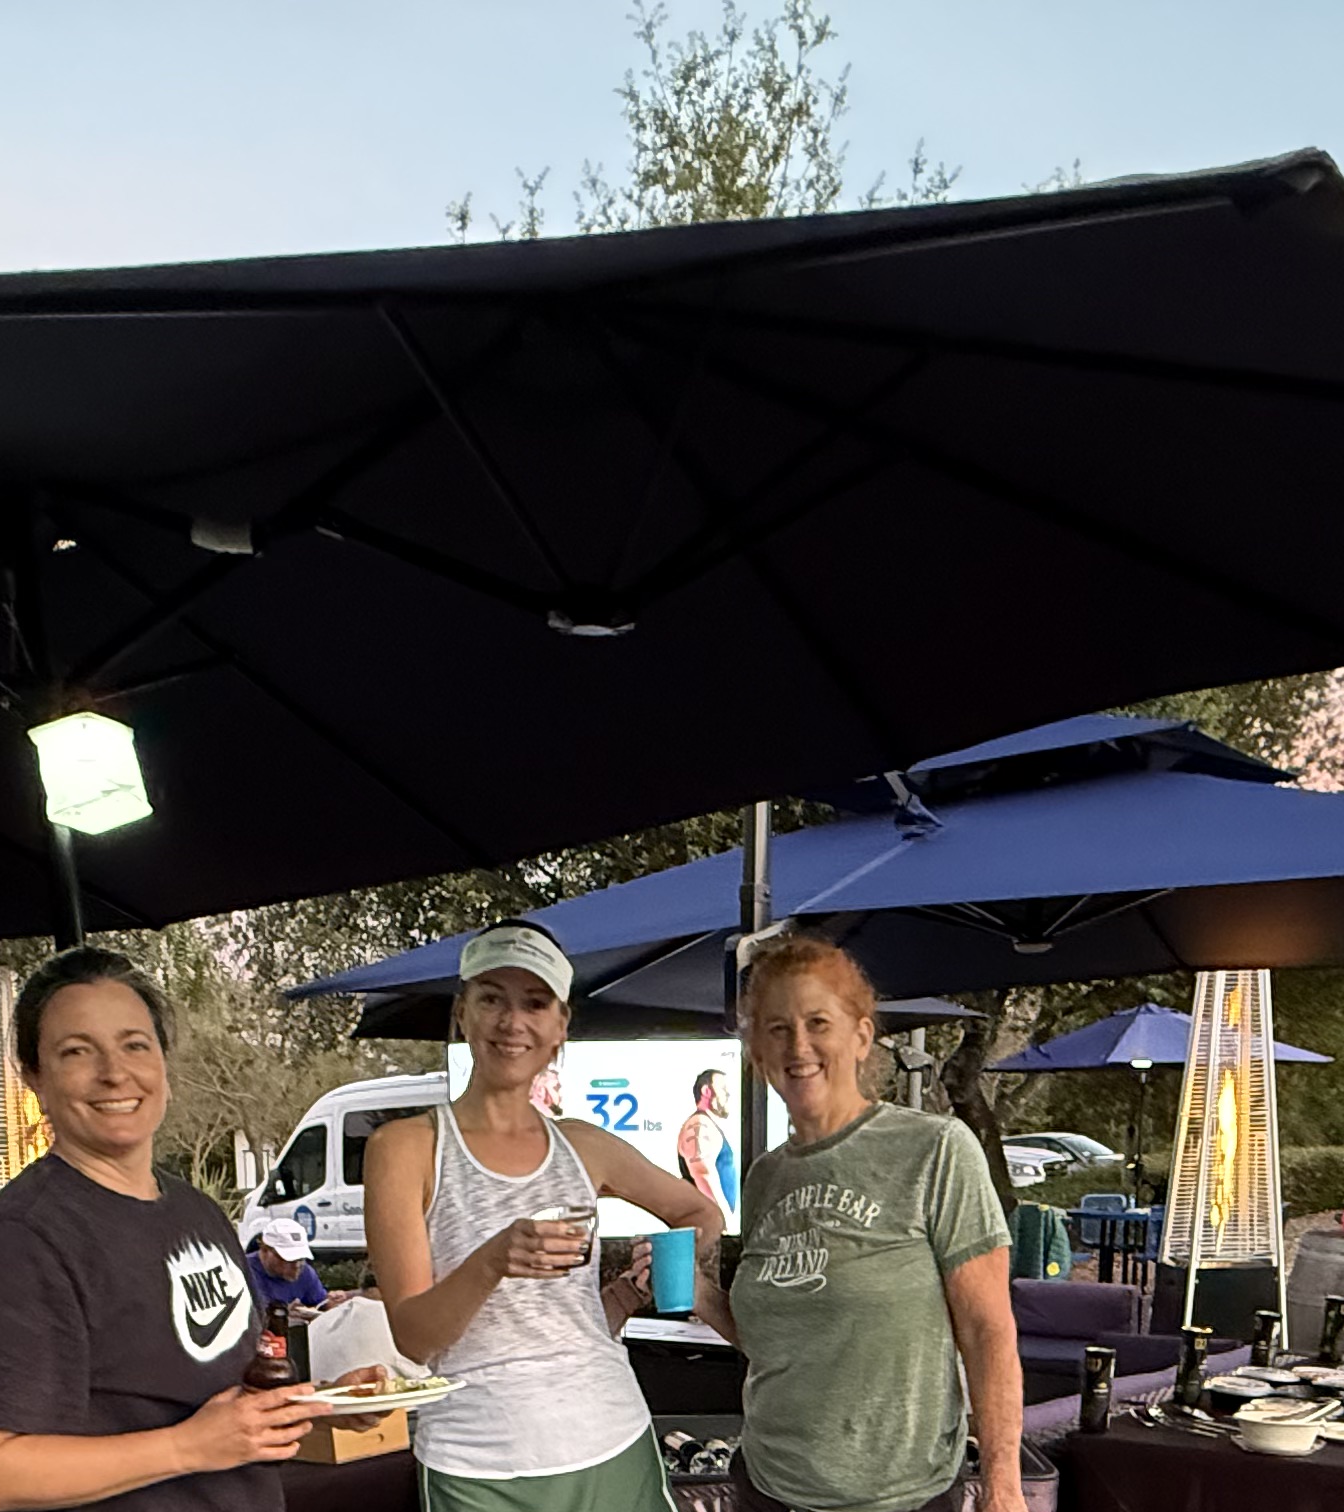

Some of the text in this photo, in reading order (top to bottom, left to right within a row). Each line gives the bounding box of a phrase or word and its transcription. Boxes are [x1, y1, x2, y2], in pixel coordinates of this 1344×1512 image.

[586, 1093, 663, 1132] 32 lbs
[778, 1183, 838, 1216] TEMPLE
[837, 1188, 881, 1228] BAR
[756, 1248, 829, 1283] IRELAND
[179, 1265, 233, 1313] NIKE
